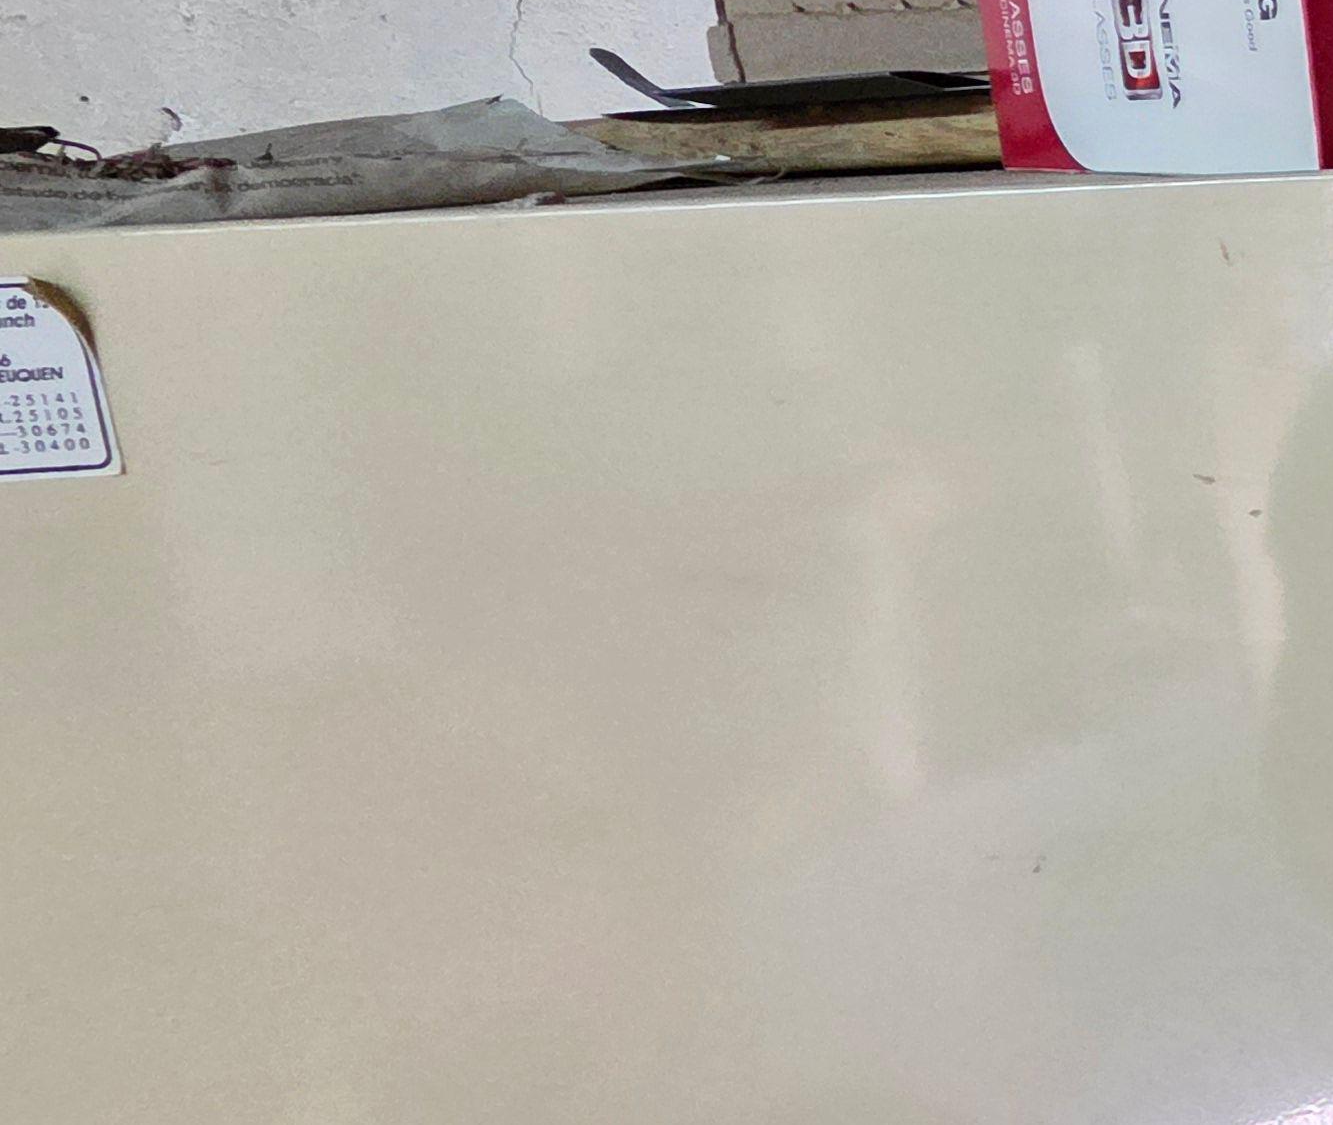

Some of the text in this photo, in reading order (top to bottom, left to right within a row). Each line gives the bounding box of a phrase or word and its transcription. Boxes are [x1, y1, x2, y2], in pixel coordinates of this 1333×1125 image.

[1244, 9, 1258, 52] Good
[6, 295, 27, 310] de
[0, 366, 63, 383] EUQUEN
